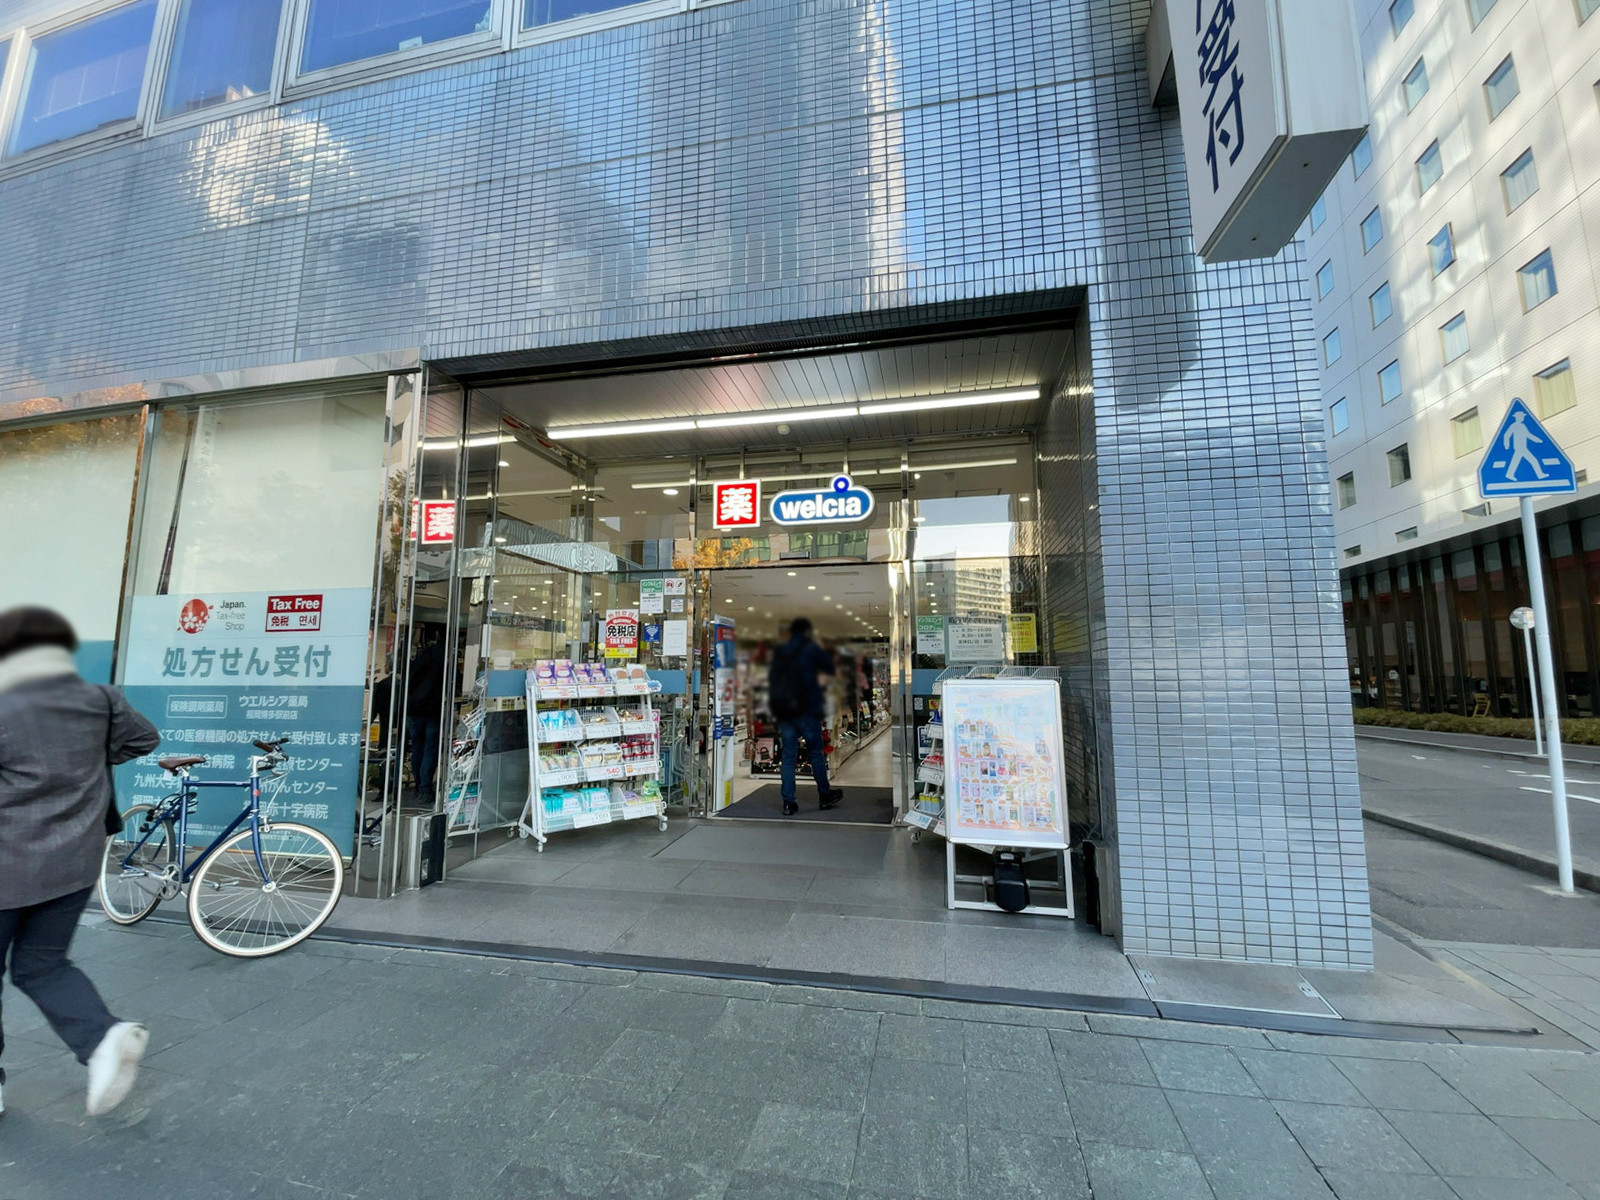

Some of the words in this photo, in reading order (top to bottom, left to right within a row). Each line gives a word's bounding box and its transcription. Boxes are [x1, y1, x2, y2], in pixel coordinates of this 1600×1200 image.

[1196, 0, 1245, 194] 受付
[720, 488, 753, 521] 薬
[780, 484, 862, 520] welcia
[271, 598, 292, 610] Tax
[294, 598, 320, 610] Free
[216, 611, 246, 620] Tax-free
[271, 615, 289, 627] 免税
[298, 615, 317, 626] 면세
[225, 622, 245, 631] Shop
[607, 625, 636, 637] 免税店
[162, 644, 332, 678] 処方せん受付
[238, 695, 308, 708] ウエルシア薬局
